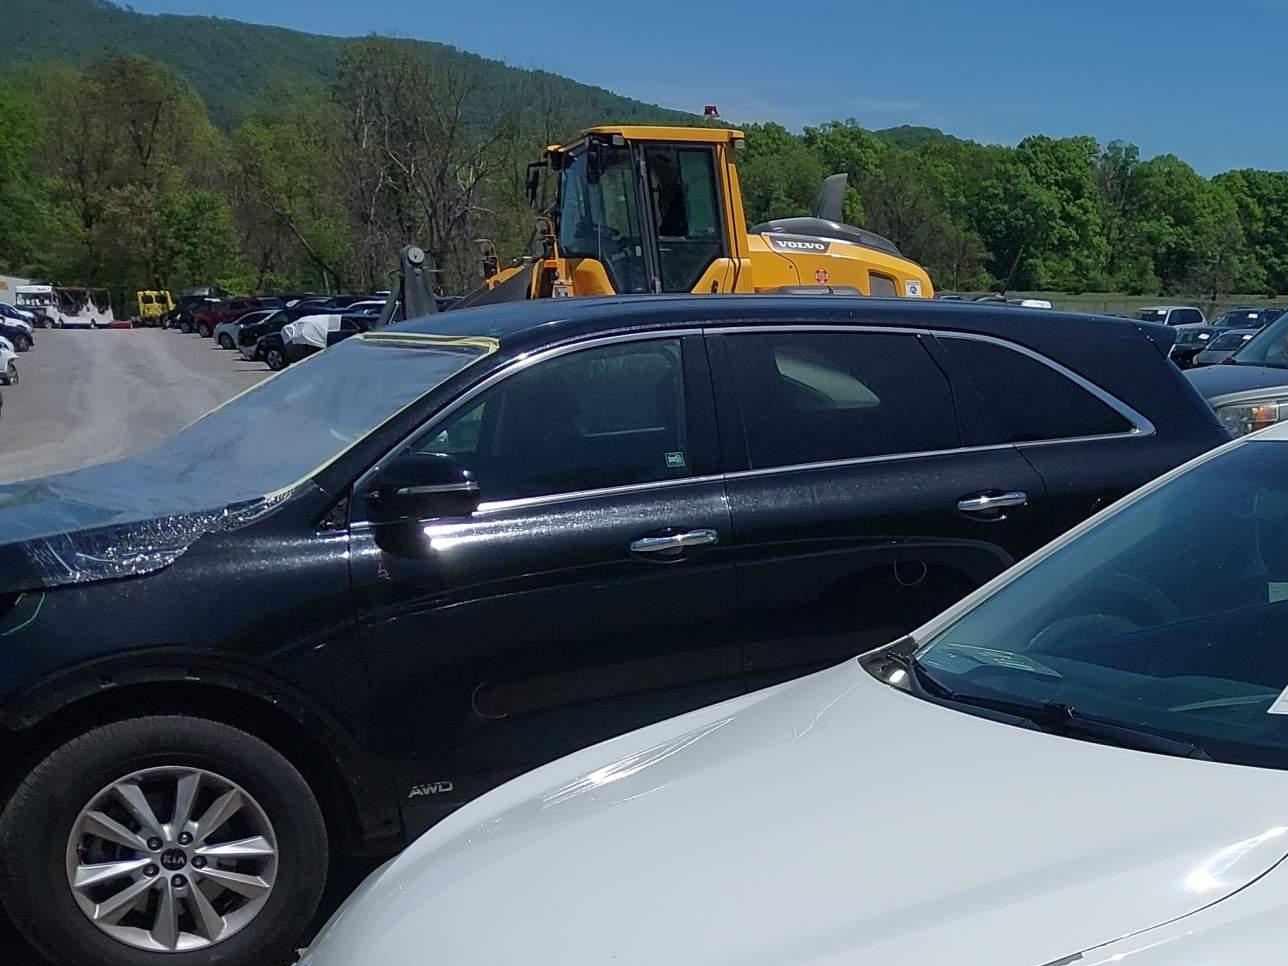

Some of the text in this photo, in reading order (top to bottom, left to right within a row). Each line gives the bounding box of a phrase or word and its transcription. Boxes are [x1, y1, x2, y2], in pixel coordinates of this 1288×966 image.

[775, 240, 825, 250] VOLVO
[408, 781, 453, 798] AWD
[162, 855, 185, 864] KIA
